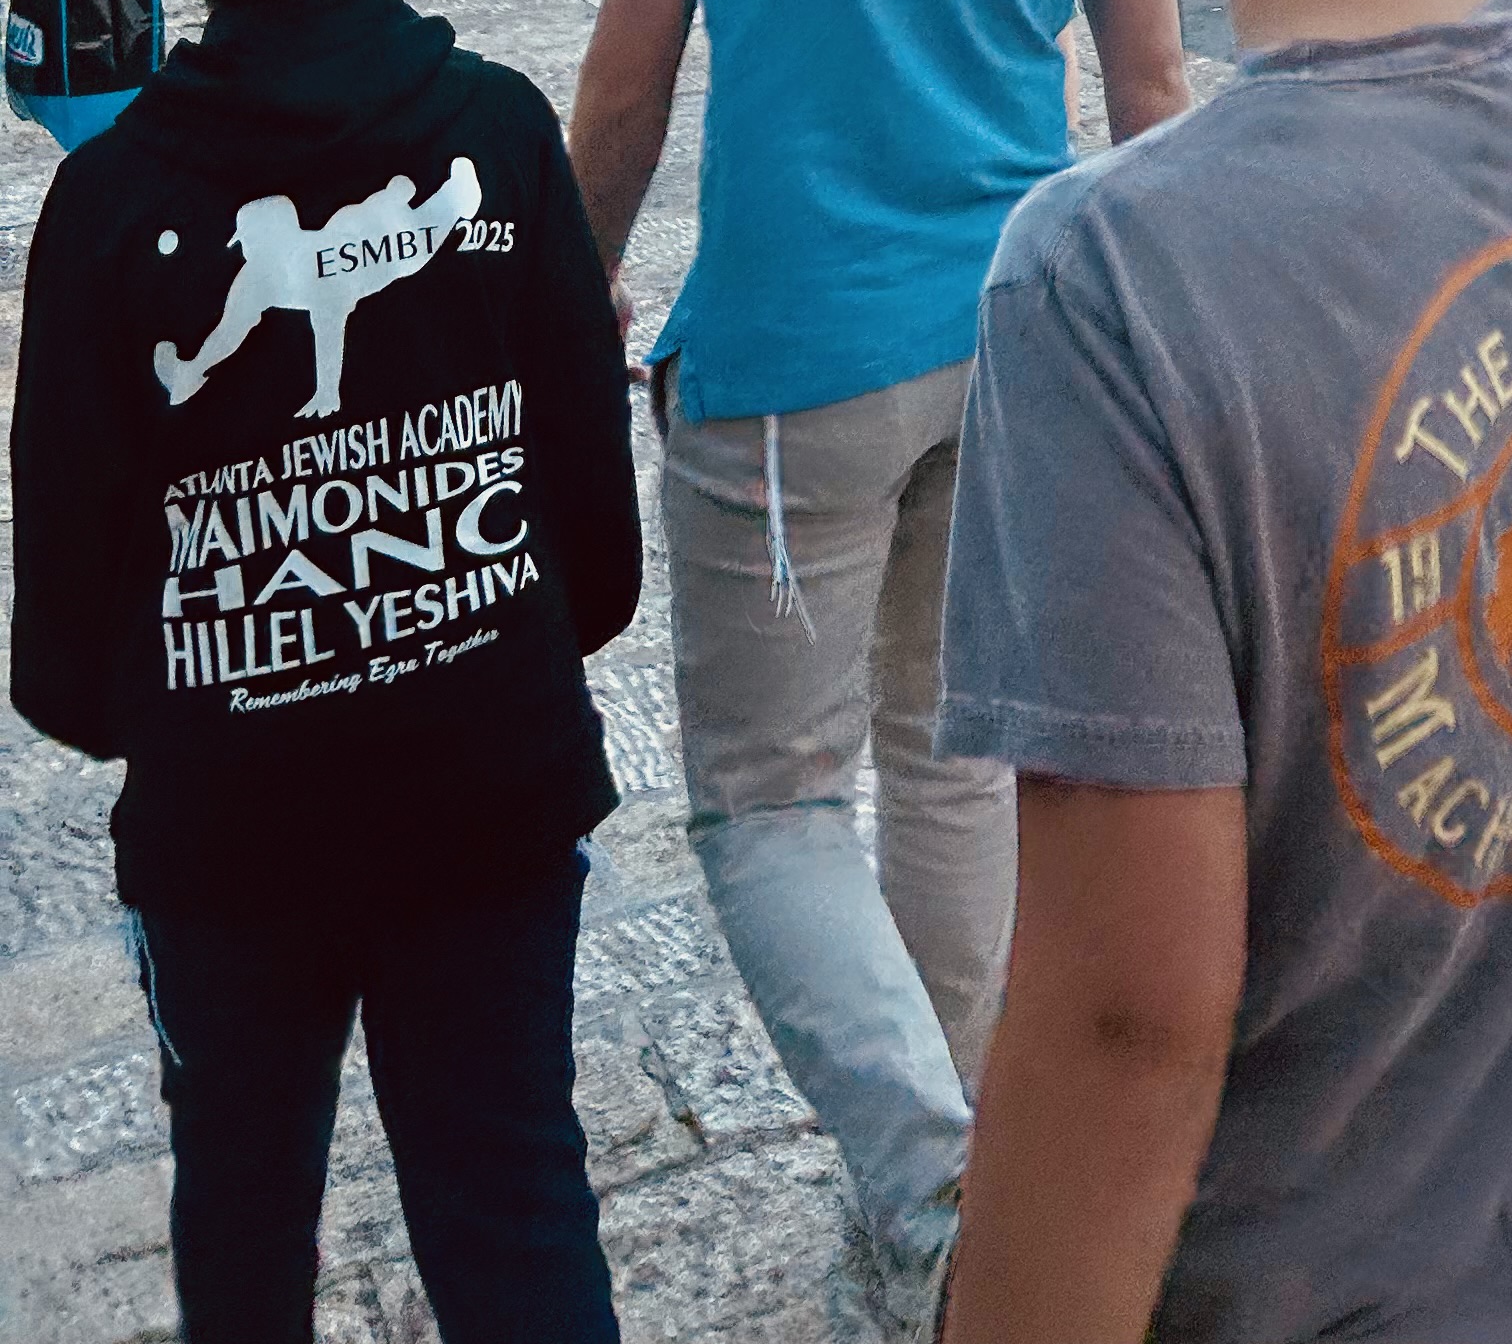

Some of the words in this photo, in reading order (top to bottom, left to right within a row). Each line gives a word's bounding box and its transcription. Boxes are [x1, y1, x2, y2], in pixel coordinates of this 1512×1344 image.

[315, 224, 438, 279] ESMBT
[455, 218, 515, 254] 2025
[281, 416, 390, 480] JEWISH
[399, 378, 522, 461] ACADEMY
[162, 479, 528, 618] HANC
[164, 445, 526, 575] MAIMONIDES
[162, 610, 336, 691] HILLEL
[343, 550, 539, 650] YESHIVA
[230, 672, 364, 714] Remembering
[424, 627, 500, 666] Together
